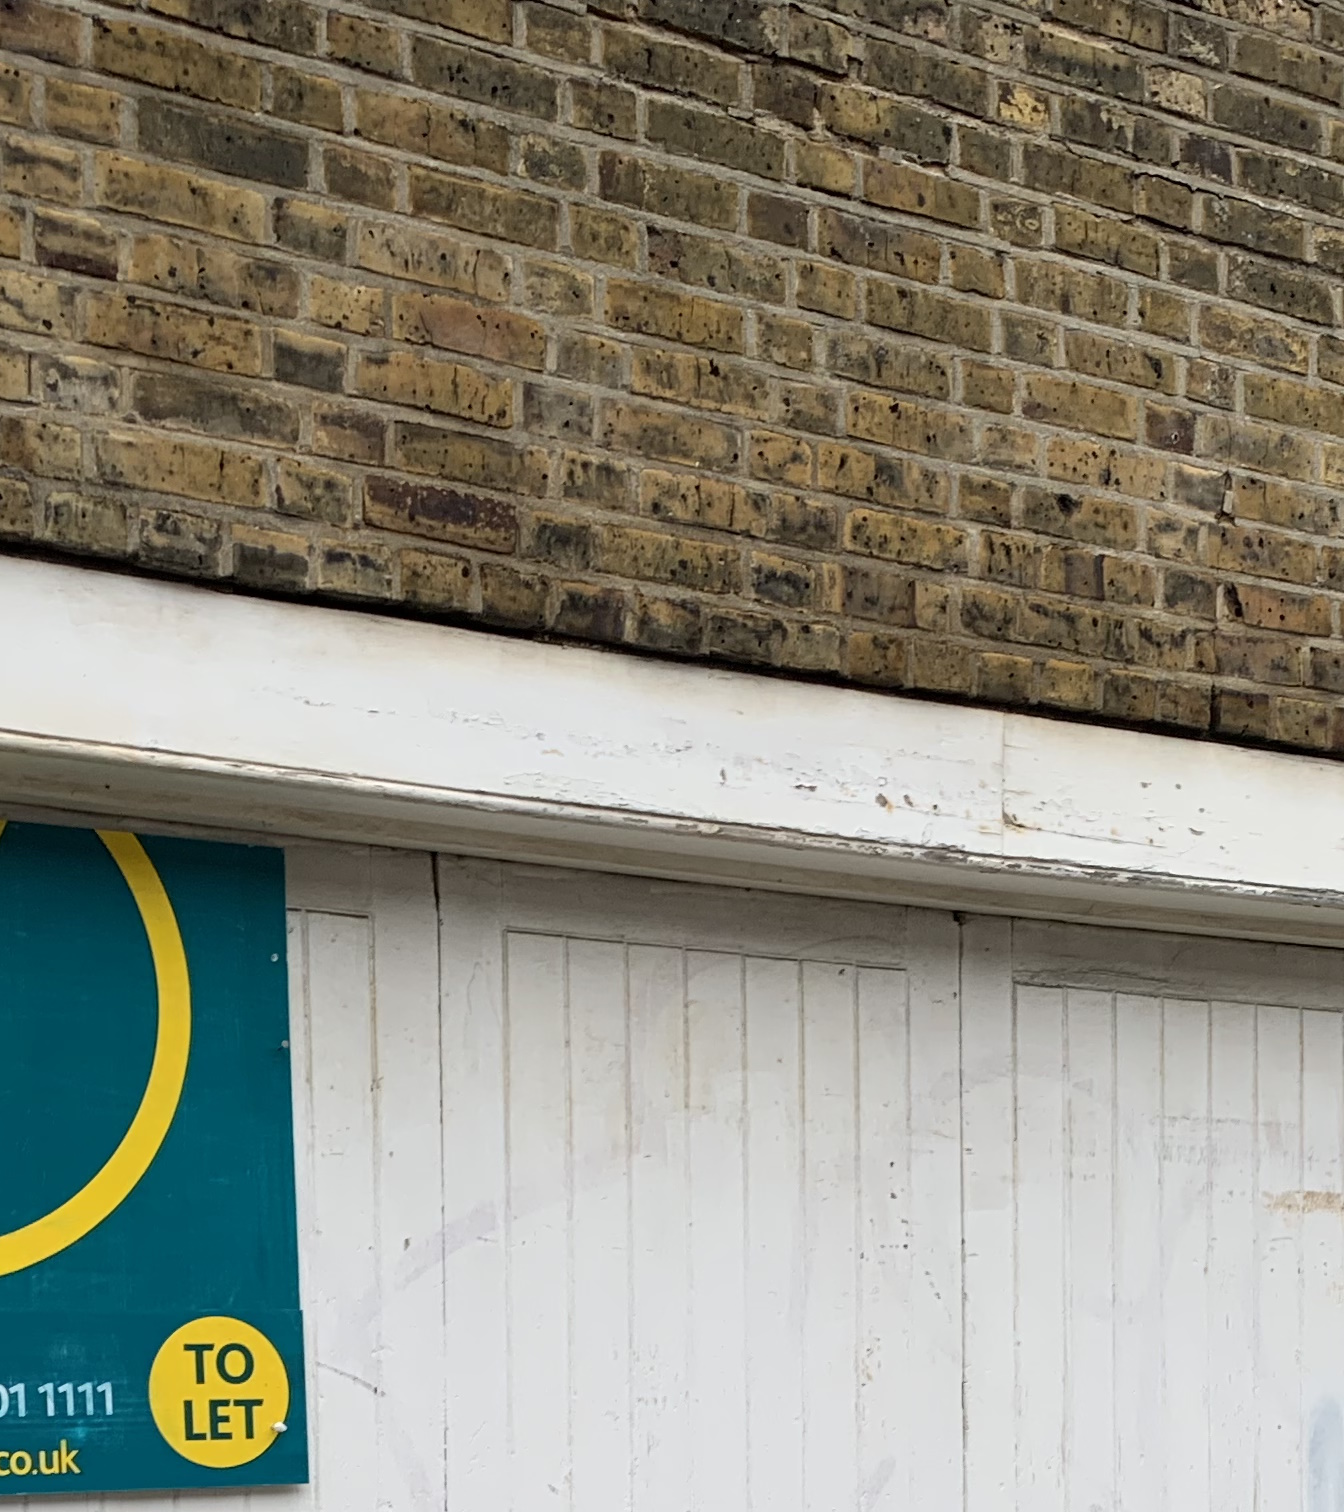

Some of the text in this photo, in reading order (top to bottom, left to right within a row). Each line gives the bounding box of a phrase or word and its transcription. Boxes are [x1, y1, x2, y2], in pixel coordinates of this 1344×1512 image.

[183, 1343, 254, 1385] TO
[37, 1381, 114, 1417] 1111
[183, 1399, 264, 1441] LET
